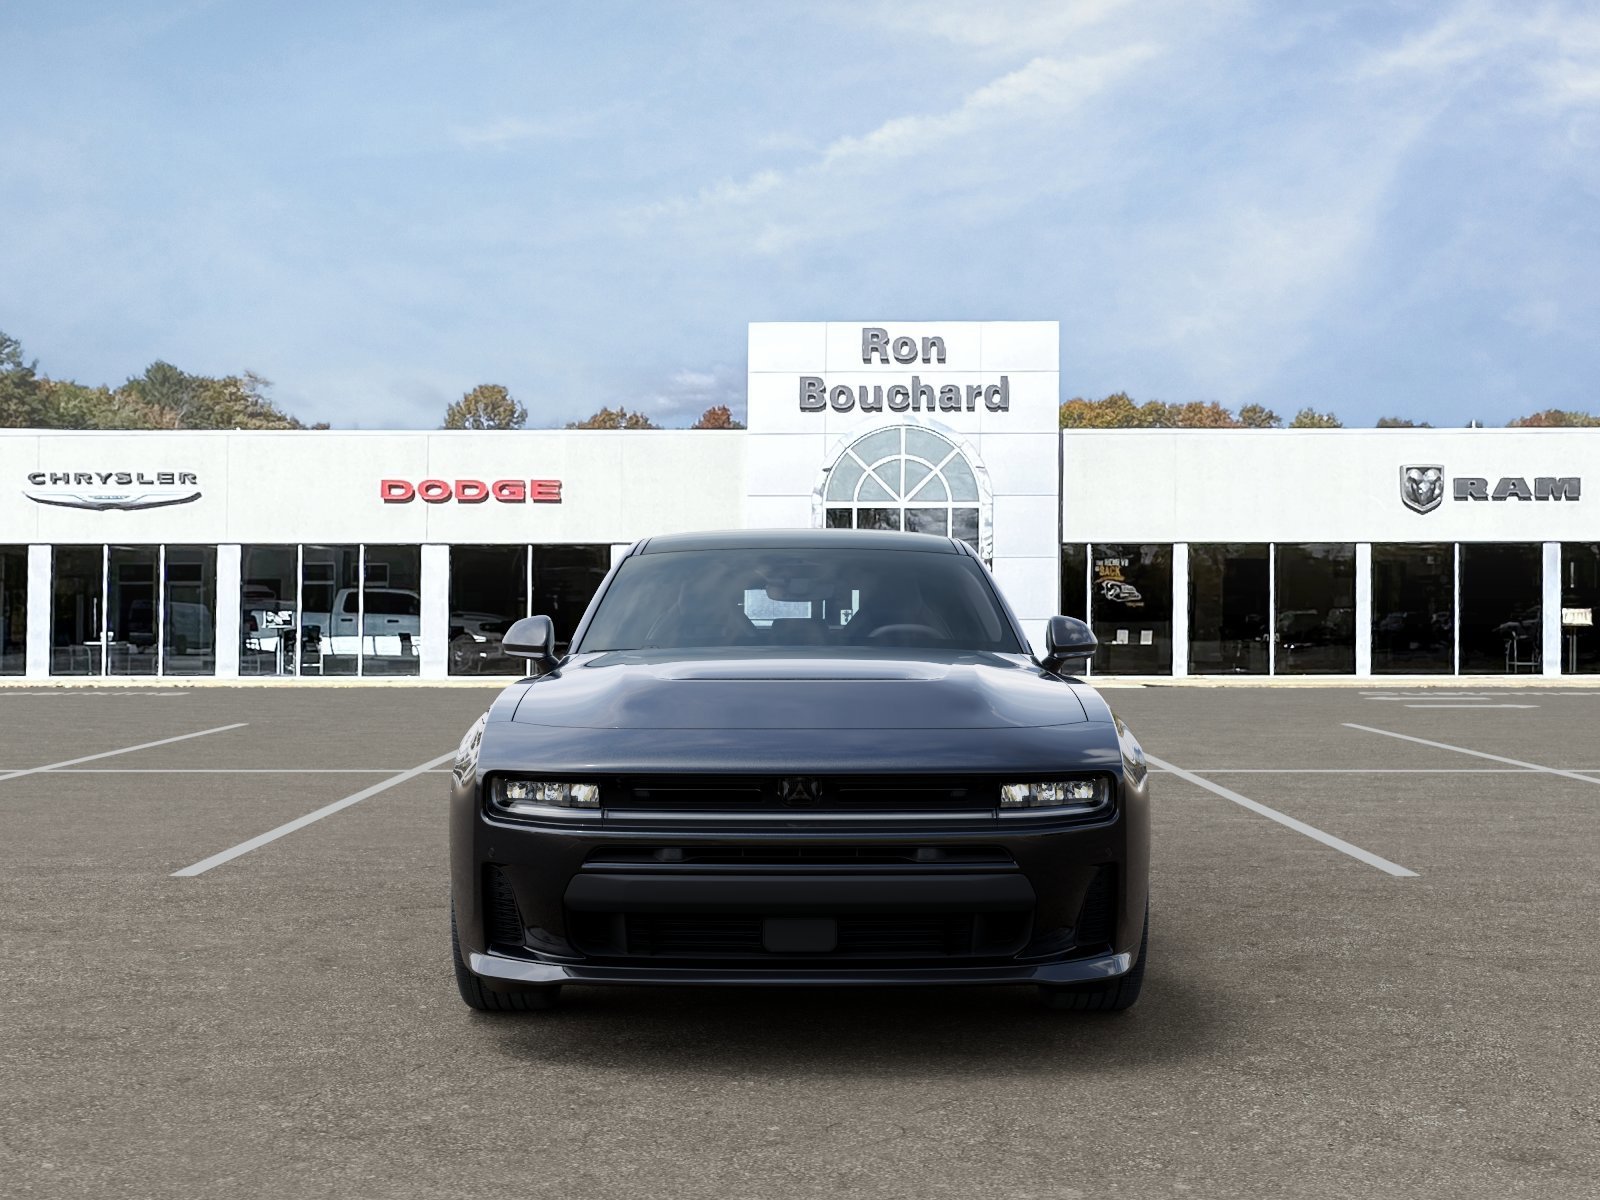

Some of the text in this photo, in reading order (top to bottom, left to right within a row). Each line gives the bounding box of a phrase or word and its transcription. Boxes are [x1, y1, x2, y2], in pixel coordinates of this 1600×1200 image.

[862, 327, 946, 364] Ron
[799, 375, 1009, 413] Bouchard
[27, 472, 197, 485] CHRYSLER
[1453, 477, 1581, 501] RAM
[380, 479, 562, 504] DODGE
